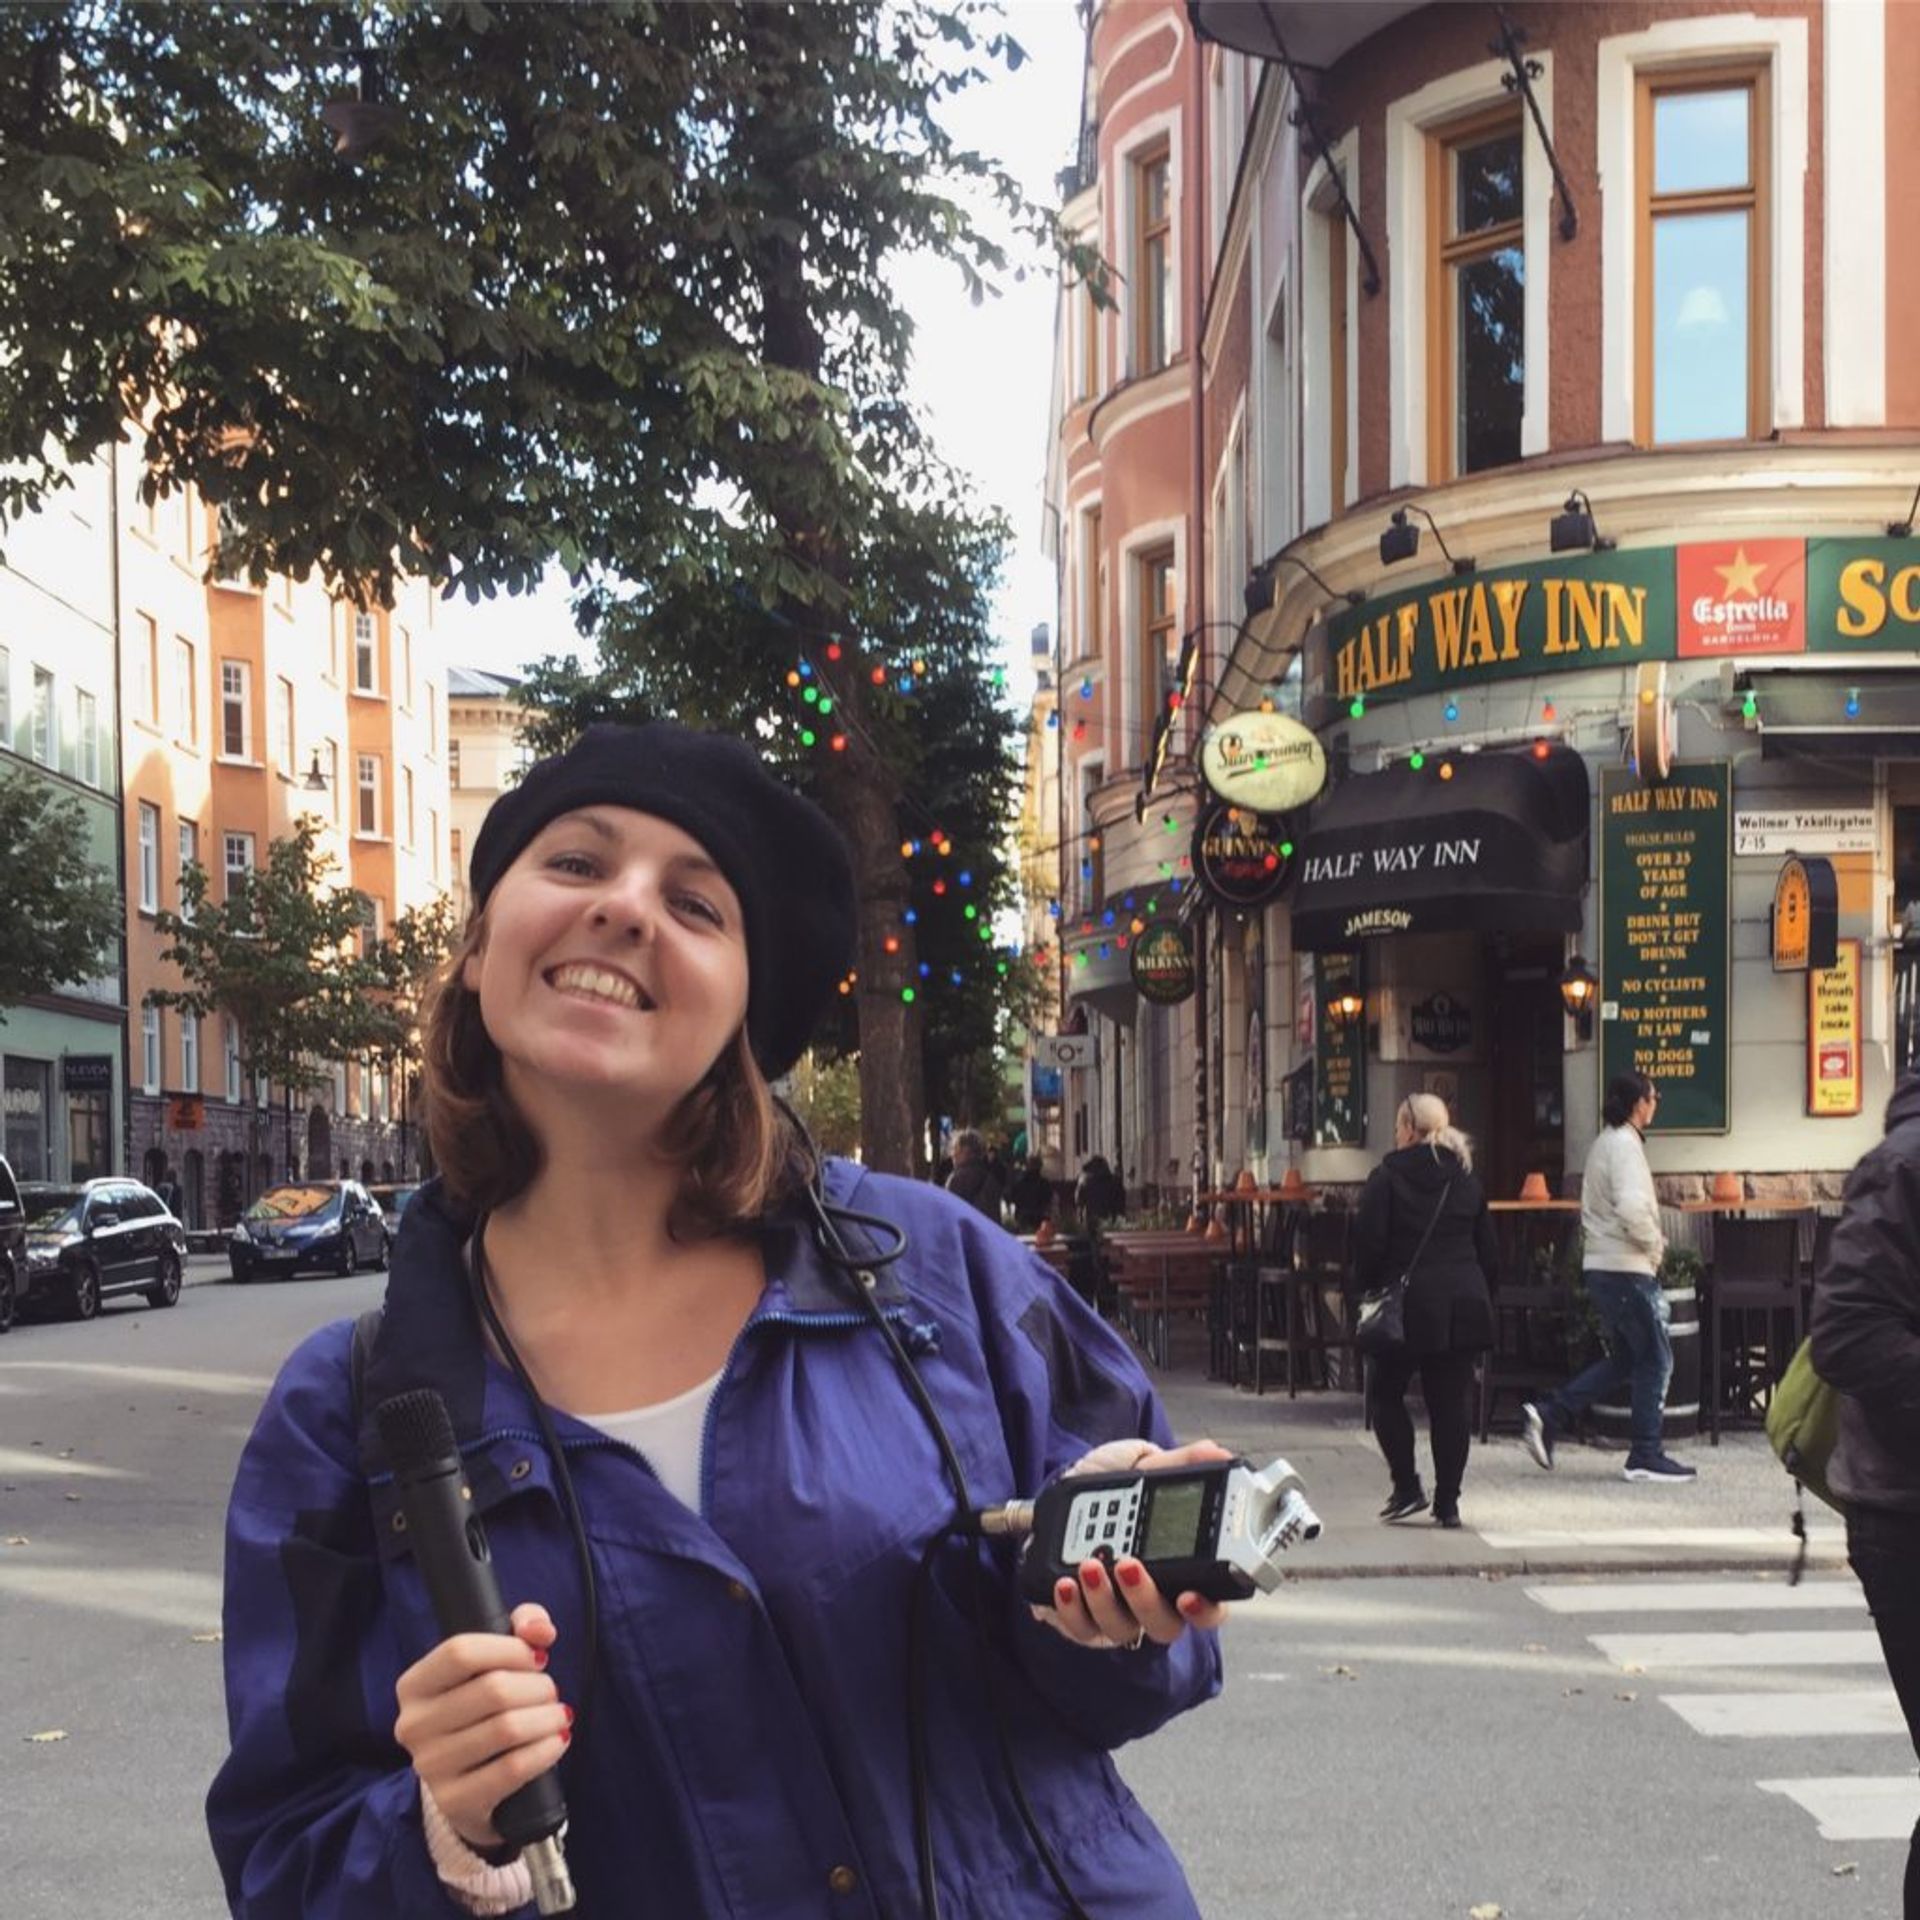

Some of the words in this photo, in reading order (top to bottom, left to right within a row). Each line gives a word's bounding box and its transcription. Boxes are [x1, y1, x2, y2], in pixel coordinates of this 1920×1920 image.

[1692, 596, 1789, 629] Estrella
[1338, 602, 1418, 699] HALF
[1429, 580, 1528, 672] WAY
[1543, 580, 1647, 653] INN
[1611, 789, 1650, 813] HALF
[1655, 787, 1685, 811] WAY
[1690, 787, 1718, 810] INN
[1303, 852, 1363, 883] HALF
[1373, 844, 1426, 873] WAY
[1433, 839, 1481, 867] INN
[1637, 853, 1671, 867] OVER
[1642, 868, 1685, 882] YEARS
[1640, 885, 1658, 899] OF
[1661, 884, 1687, 898] AGE
[1344, 909, 1412, 937] JAMESON
[1627, 915, 1670, 929] DRINK
[1674, 913, 1701, 927] BUT
[1673, 930, 1699, 943] GET
[1640, 946, 1687, 961] DRUNK
[1622, 979, 1641, 993] NO
[1645, 977, 1706, 991] CYCLISTS
[1621, 1008, 1640, 1022] NO
[1644, 1006, 1708, 1020] MOTHERS
[1638, 1023, 1653, 1037] IN
[1657, 1022, 1682, 1036] LAW
[1634, 1050, 1654, 1064] NO
[1657, 1048, 1693, 1062] DOGS
[1635, 1064, 1695, 1078] LLOWED
